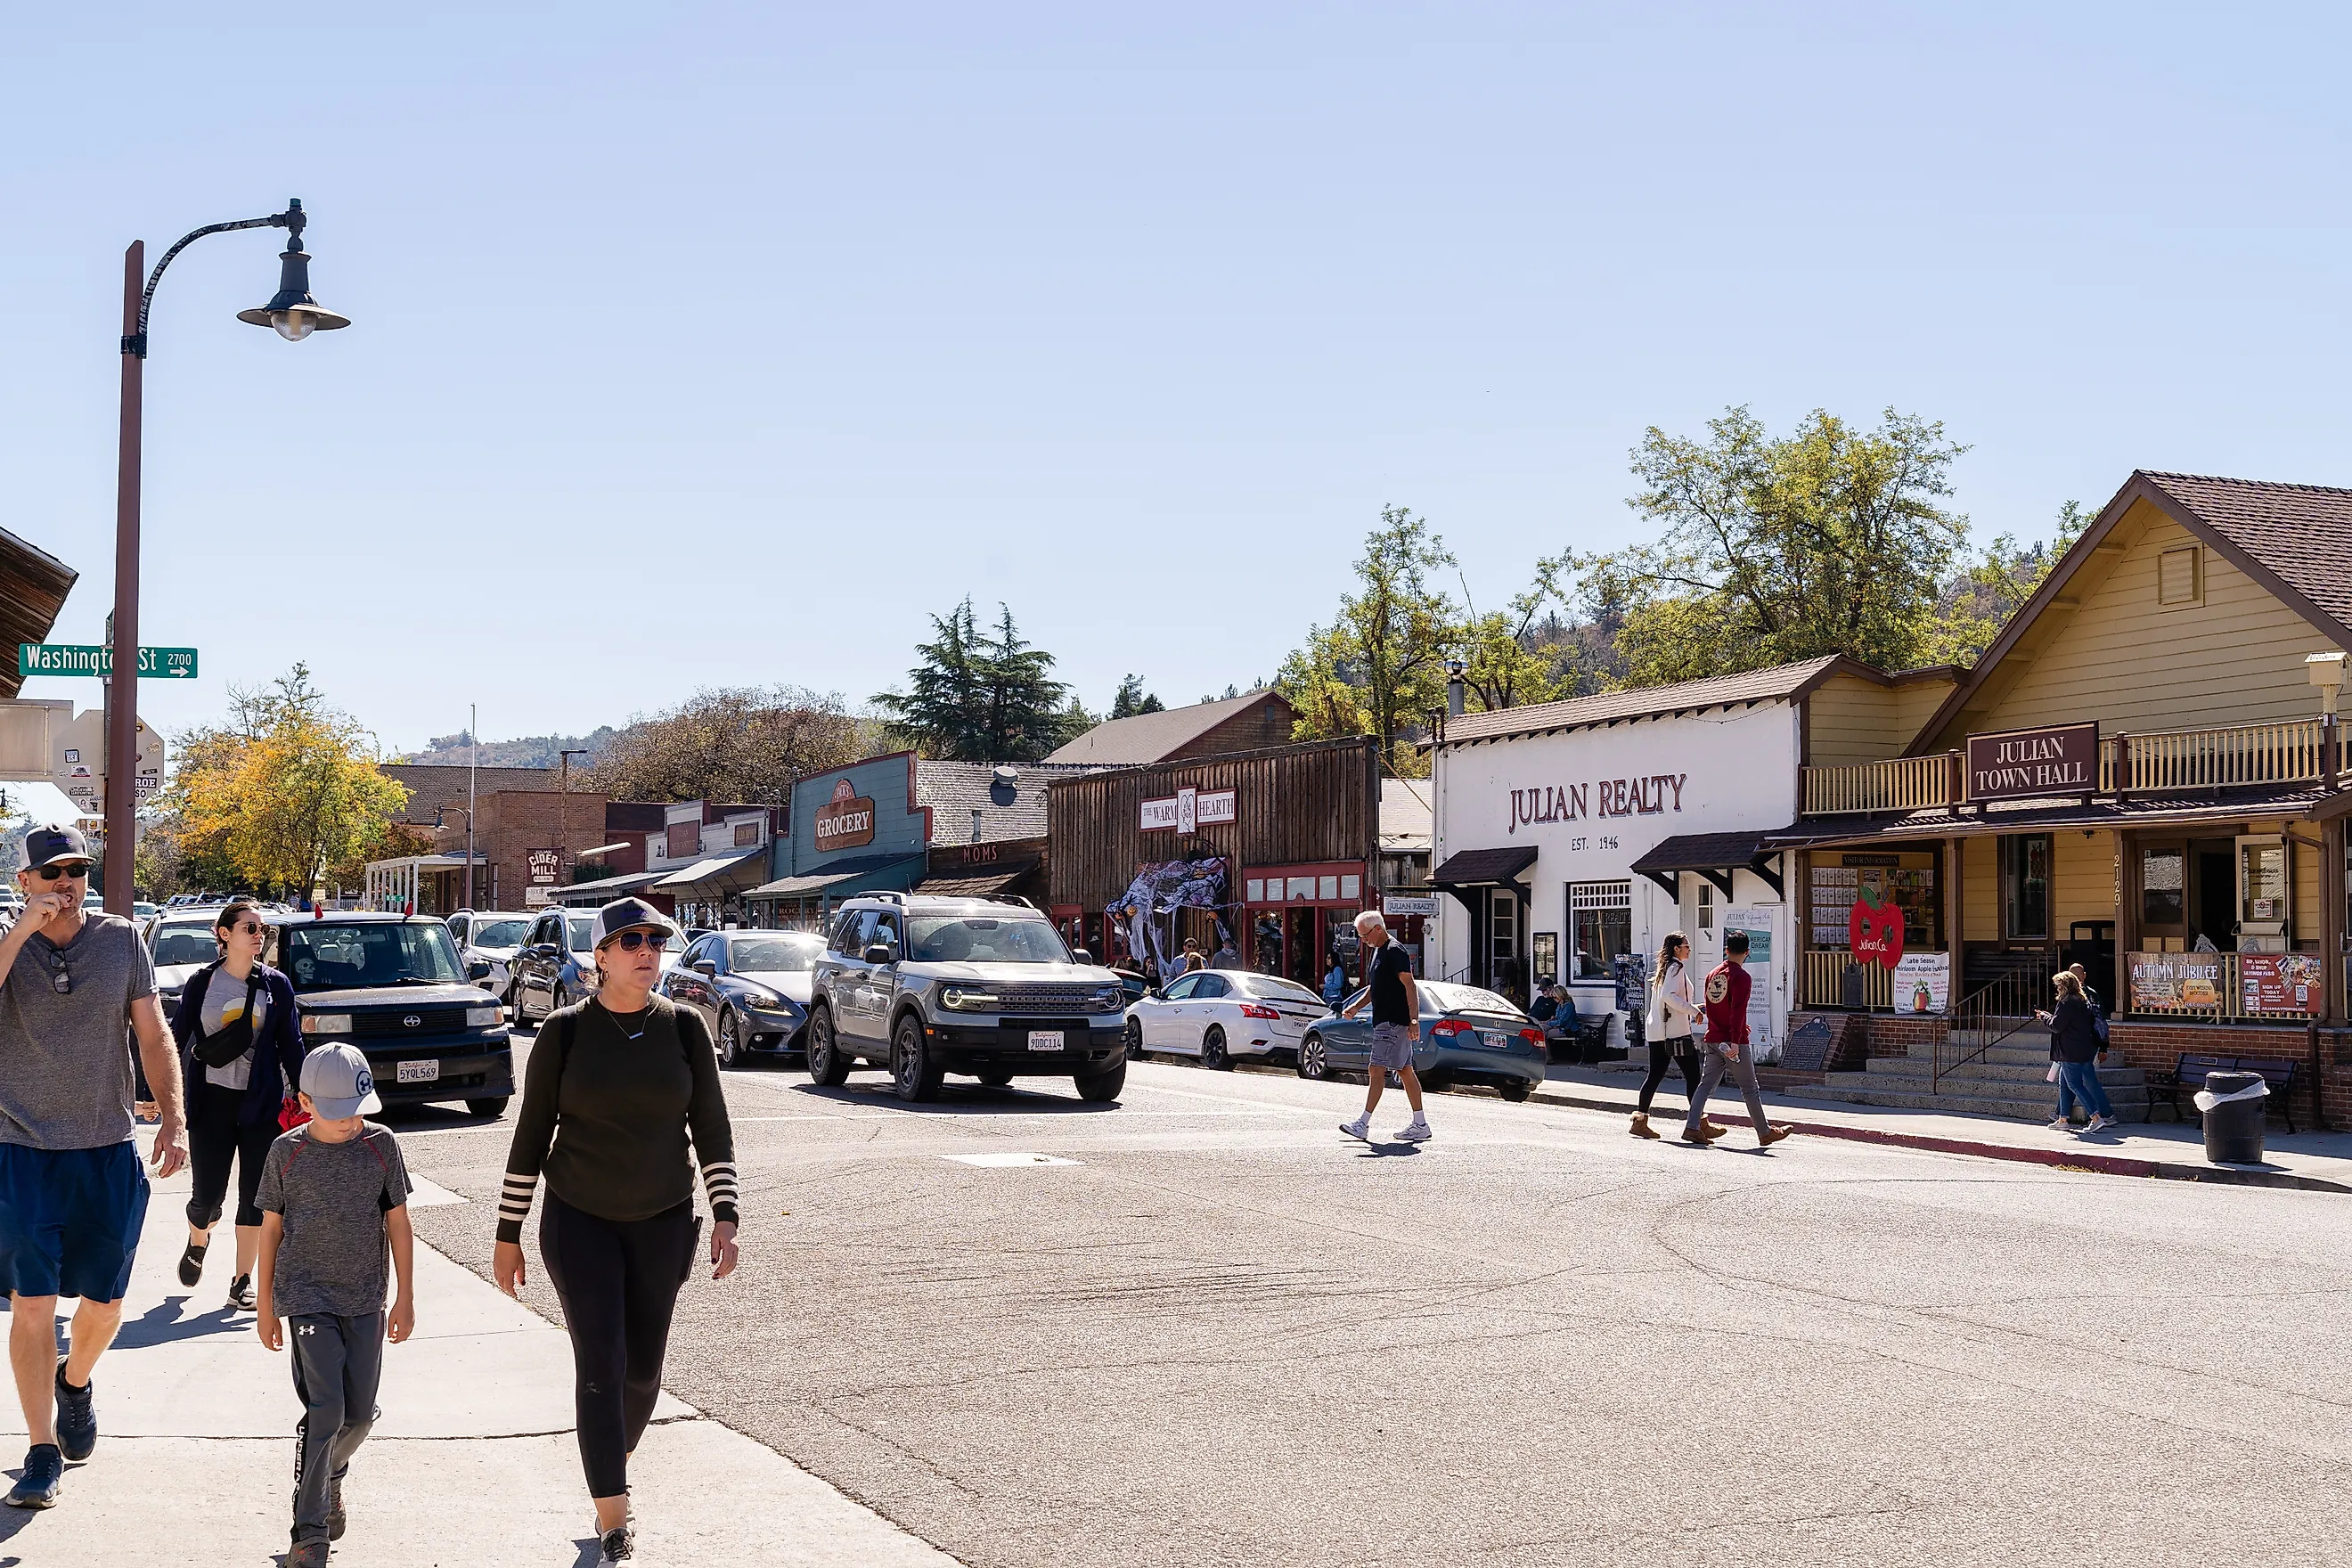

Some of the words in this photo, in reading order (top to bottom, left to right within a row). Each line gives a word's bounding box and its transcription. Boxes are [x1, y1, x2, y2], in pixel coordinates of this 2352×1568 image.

[26, 645, 114, 676] Washingt
[138, 648, 156, 671] St
[167, 653, 192, 666] 2700
[1997, 736, 2064, 764] JULIAN
[1976, 766, 2031, 791] TOWN
[2036, 762, 2088, 786] HALL
[1143, 806, 1153, 817] THE
[1198, 798, 1234, 817] HEARTH
[1508, 782, 1588, 836] JULIAN
[1598, 773, 1687, 820] REALTY
[817, 811, 870, 837] GROCERY
[1572, 836, 1589, 852] EST.
[1599, 836, 1619, 850] 1946
[527, 854, 559, 866] CIDER
[963, 845, 997, 863] MOMS
[531, 865, 557, 876] MILL
[2113, 853, 2121, 906] 2129
[1388, 902, 1411, 911] JULIAN
[1412, 902, 1434, 911] REALTY
[1858, 938, 1878, 950] Julian
[2132, 962, 2174, 981] AUTUMN
[2177, 964, 2218, 980] JUBILEE
[1031, 1038, 1062, 1049] 9DDC114
[400, 1067, 437, 1080] 5YQL569
